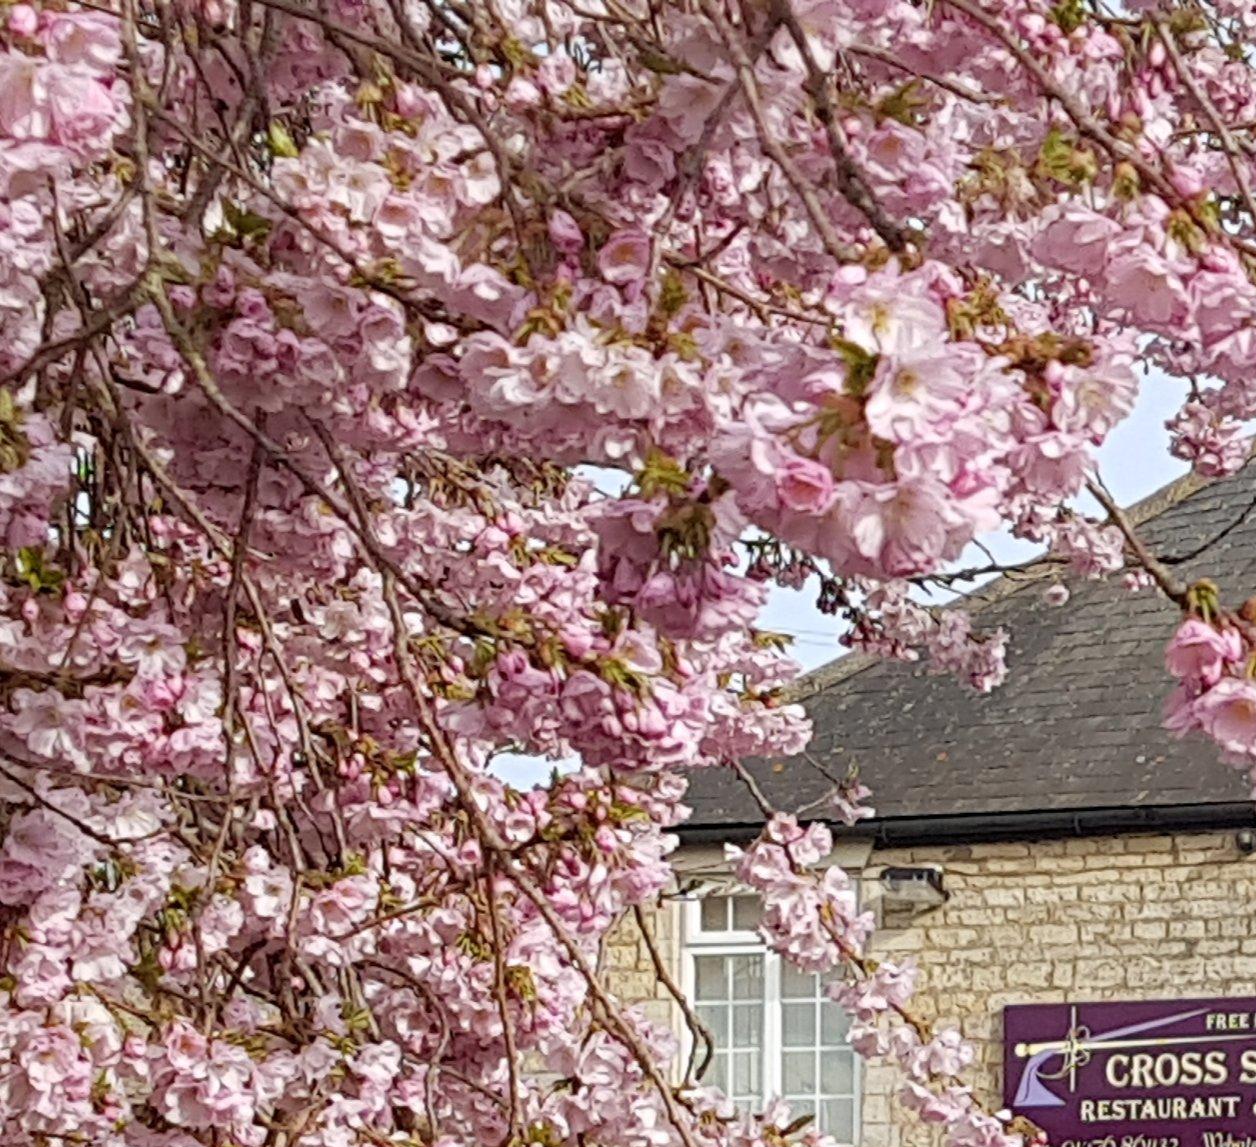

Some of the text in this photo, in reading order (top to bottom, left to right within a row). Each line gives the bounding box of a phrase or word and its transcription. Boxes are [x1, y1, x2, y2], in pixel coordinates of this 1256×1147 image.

[1206, 1013, 1249, 1030] FREE
[1105, 1052, 1229, 1088] CROSS
[1080, 1096, 1241, 1121] RESTAURANT
